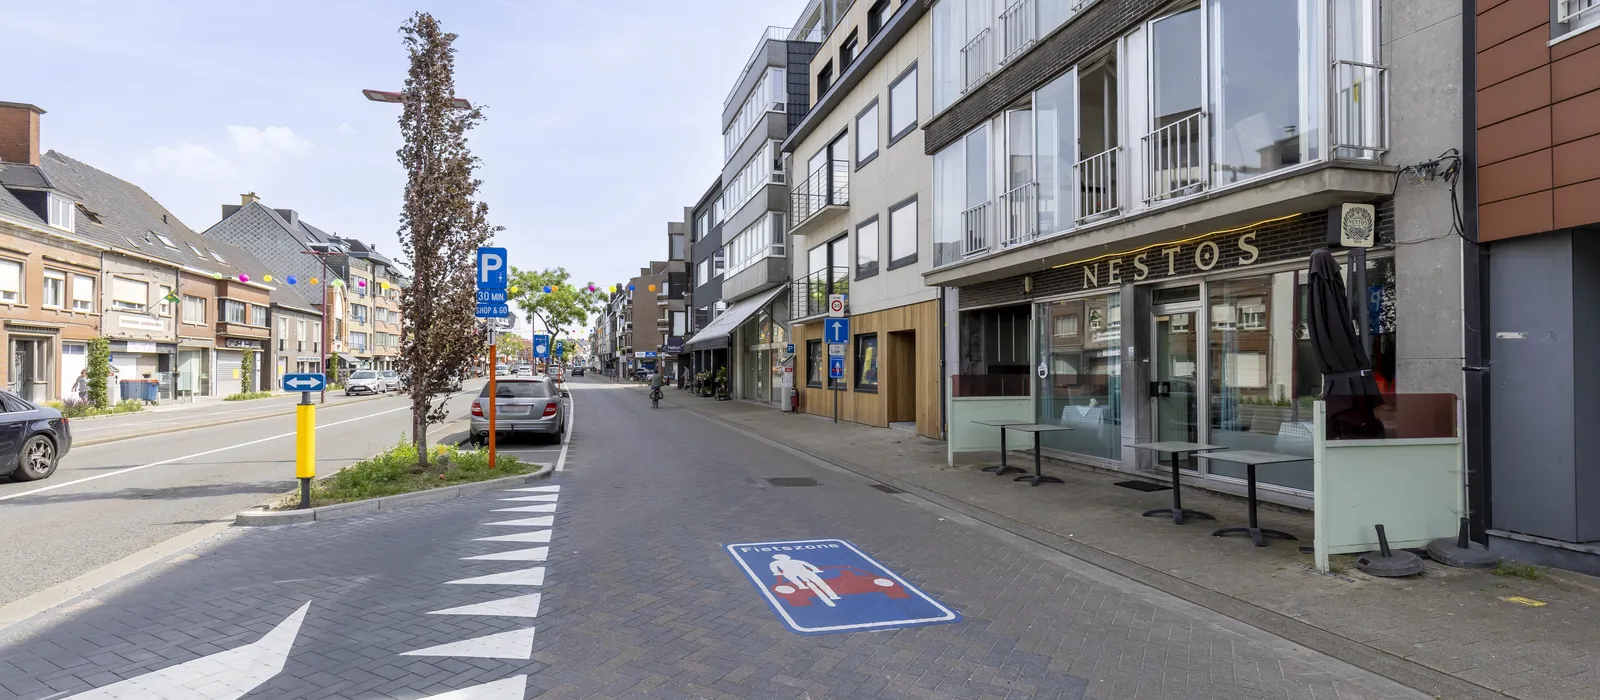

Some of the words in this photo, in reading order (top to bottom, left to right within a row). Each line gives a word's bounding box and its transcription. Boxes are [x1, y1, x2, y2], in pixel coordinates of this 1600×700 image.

[1082, 230, 1260, 289] NESTOS
[481, 253, 503, 283] P
[478, 292, 489, 301] 30
[476, 306, 492, 315] SHOP
[493, 306, 498, 314] &
[499, 306, 508, 314] GO
[741, 543, 839, 552] Fietszone
